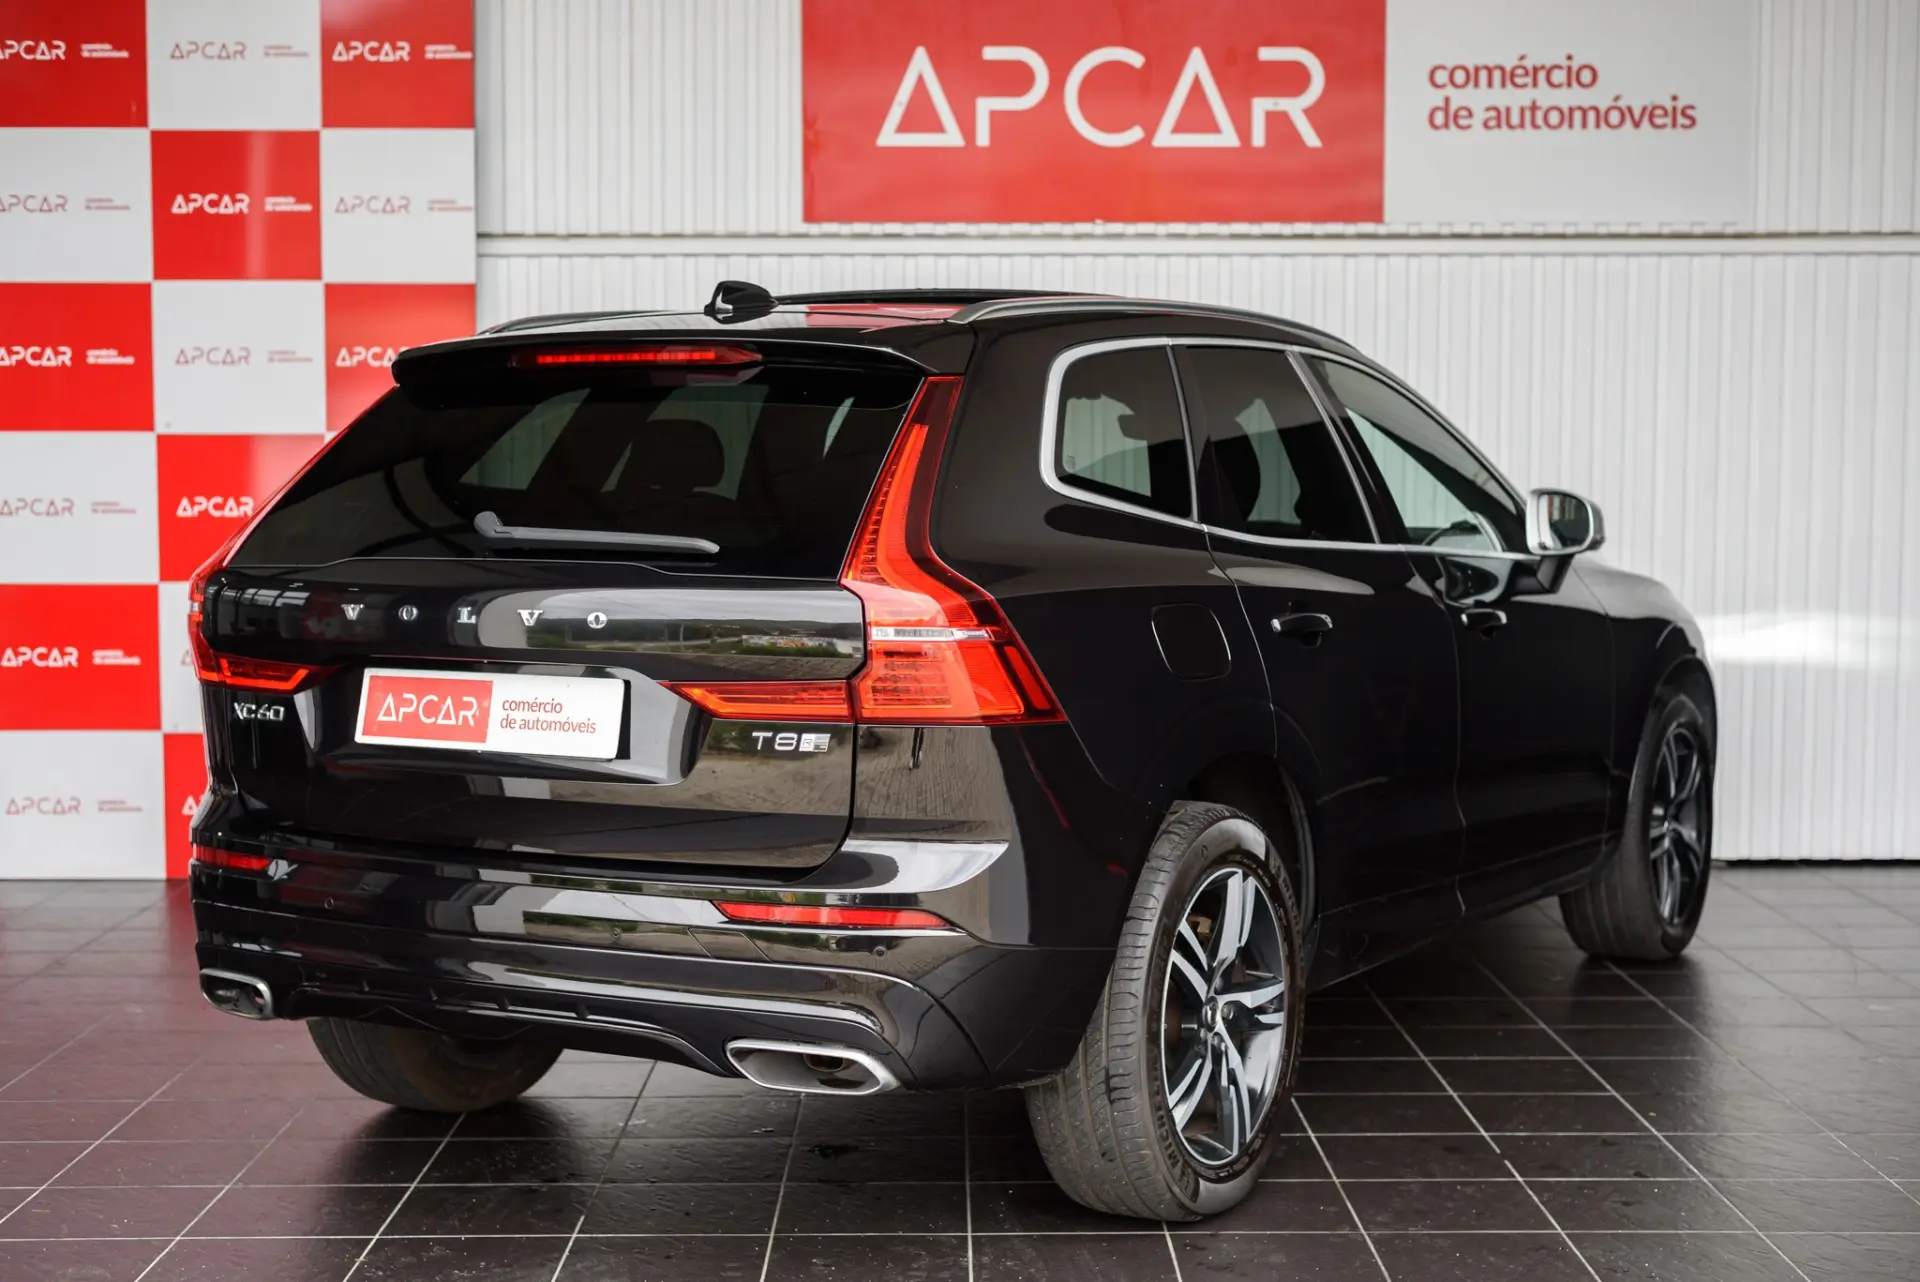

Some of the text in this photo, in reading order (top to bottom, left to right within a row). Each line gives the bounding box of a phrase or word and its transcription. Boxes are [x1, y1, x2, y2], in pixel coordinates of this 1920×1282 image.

[0, 40, 66, 60] PCAR
[170, 41, 247, 60] APCAR
[331, 41, 411, 62] APCAR
[1428, 54, 1598, 89] comércio
[876, 46, 1325, 147] APCAR
[1427, 95, 1697, 131] de automóveis
[171, 193, 250, 214] APCAR
[334, 195, 411, 214] APCAR
[0, 345, 72, 367] APCAR
[174, 346, 251, 366] APCAR
[335, 346, 410, 368] APCA
[0, 498, 75, 517] APCAR
[176, 496, 254, 518] APCAR
[341, 603, 608, 630] VOLVO
[1, 646, 79, 668] APCAR
[233, 702, 285, 721] XC60
[377, 693, 478, 727] APCAR
[502, 698, 562, 714] comércio
[500, 714, 596, 734] de automóveis
[752, 731, 798, 751] T8
[5, 796, 82, 815] APCAR
